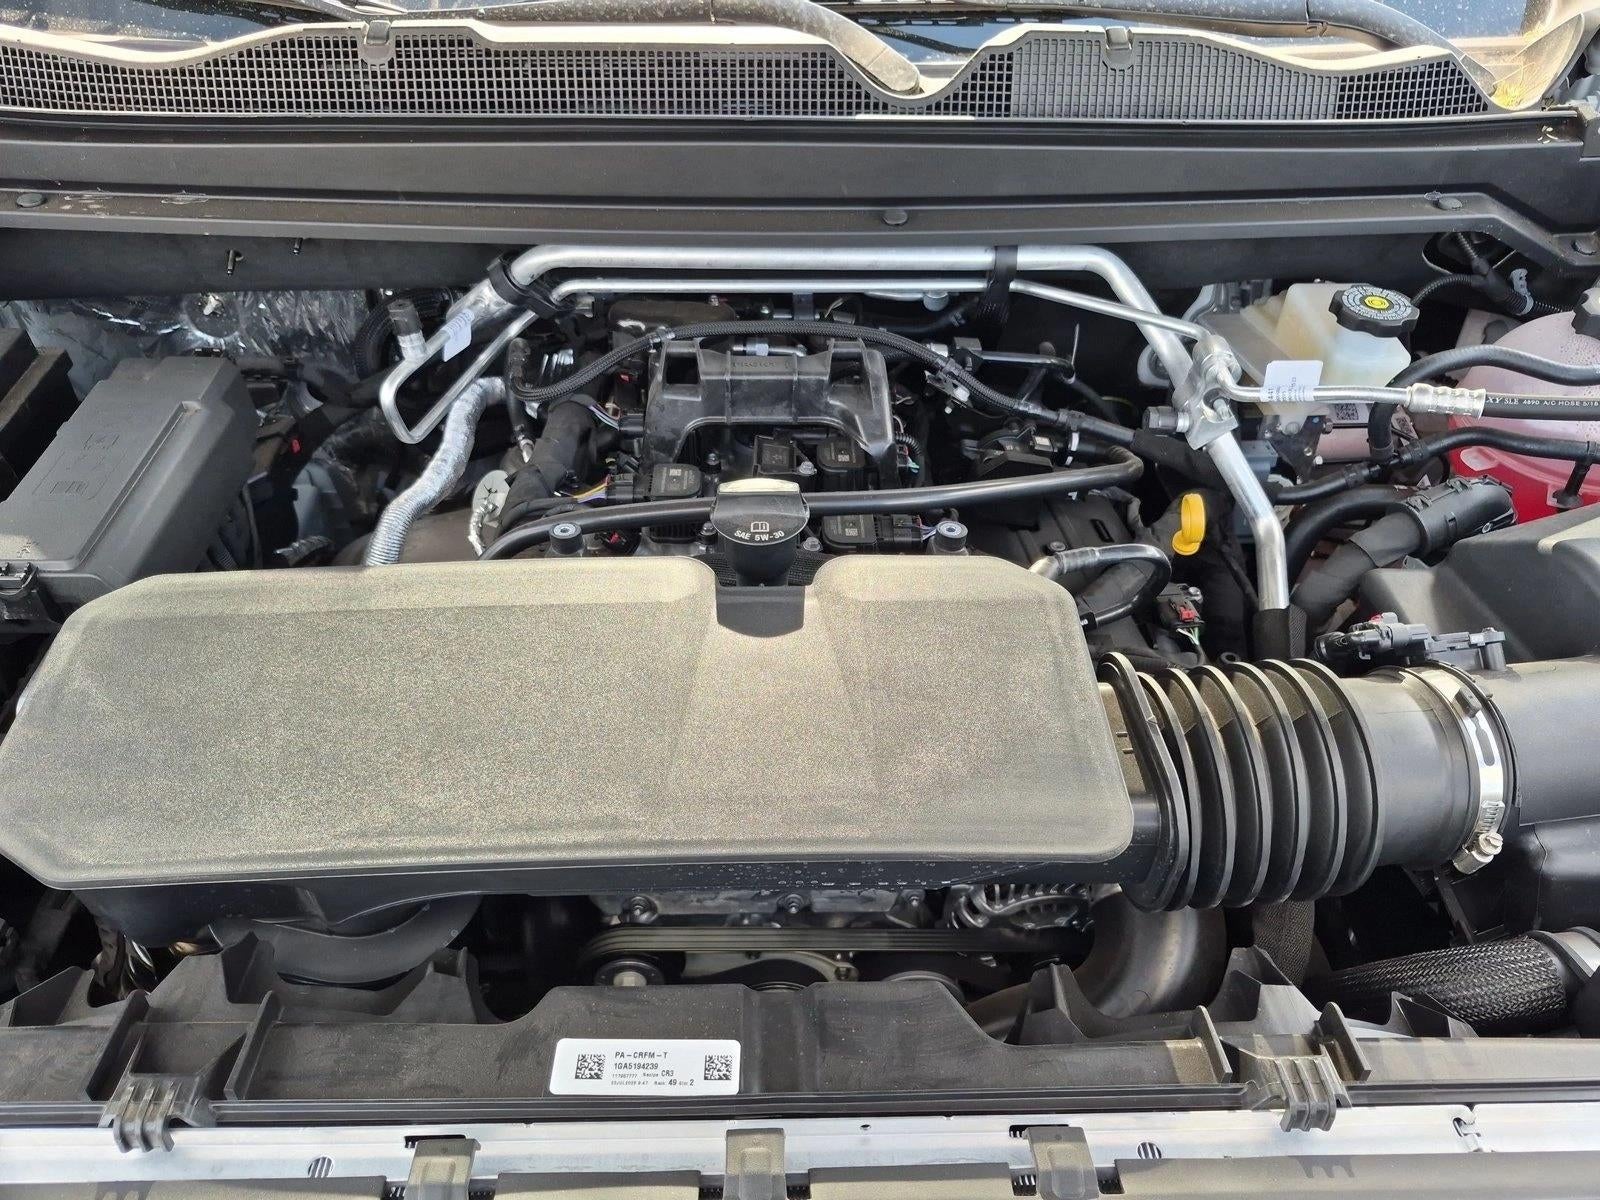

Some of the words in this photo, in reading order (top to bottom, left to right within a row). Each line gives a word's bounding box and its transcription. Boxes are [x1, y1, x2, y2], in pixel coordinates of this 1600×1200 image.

[1504, 397, 1519, 405] SLE
[734, 530, 751, 540] SAE
[754, 530, 785, 541] 5W-30
[614, 1062, 659, 1070] 1GA5194239
[661, 1069, 674, 1077] CR3
